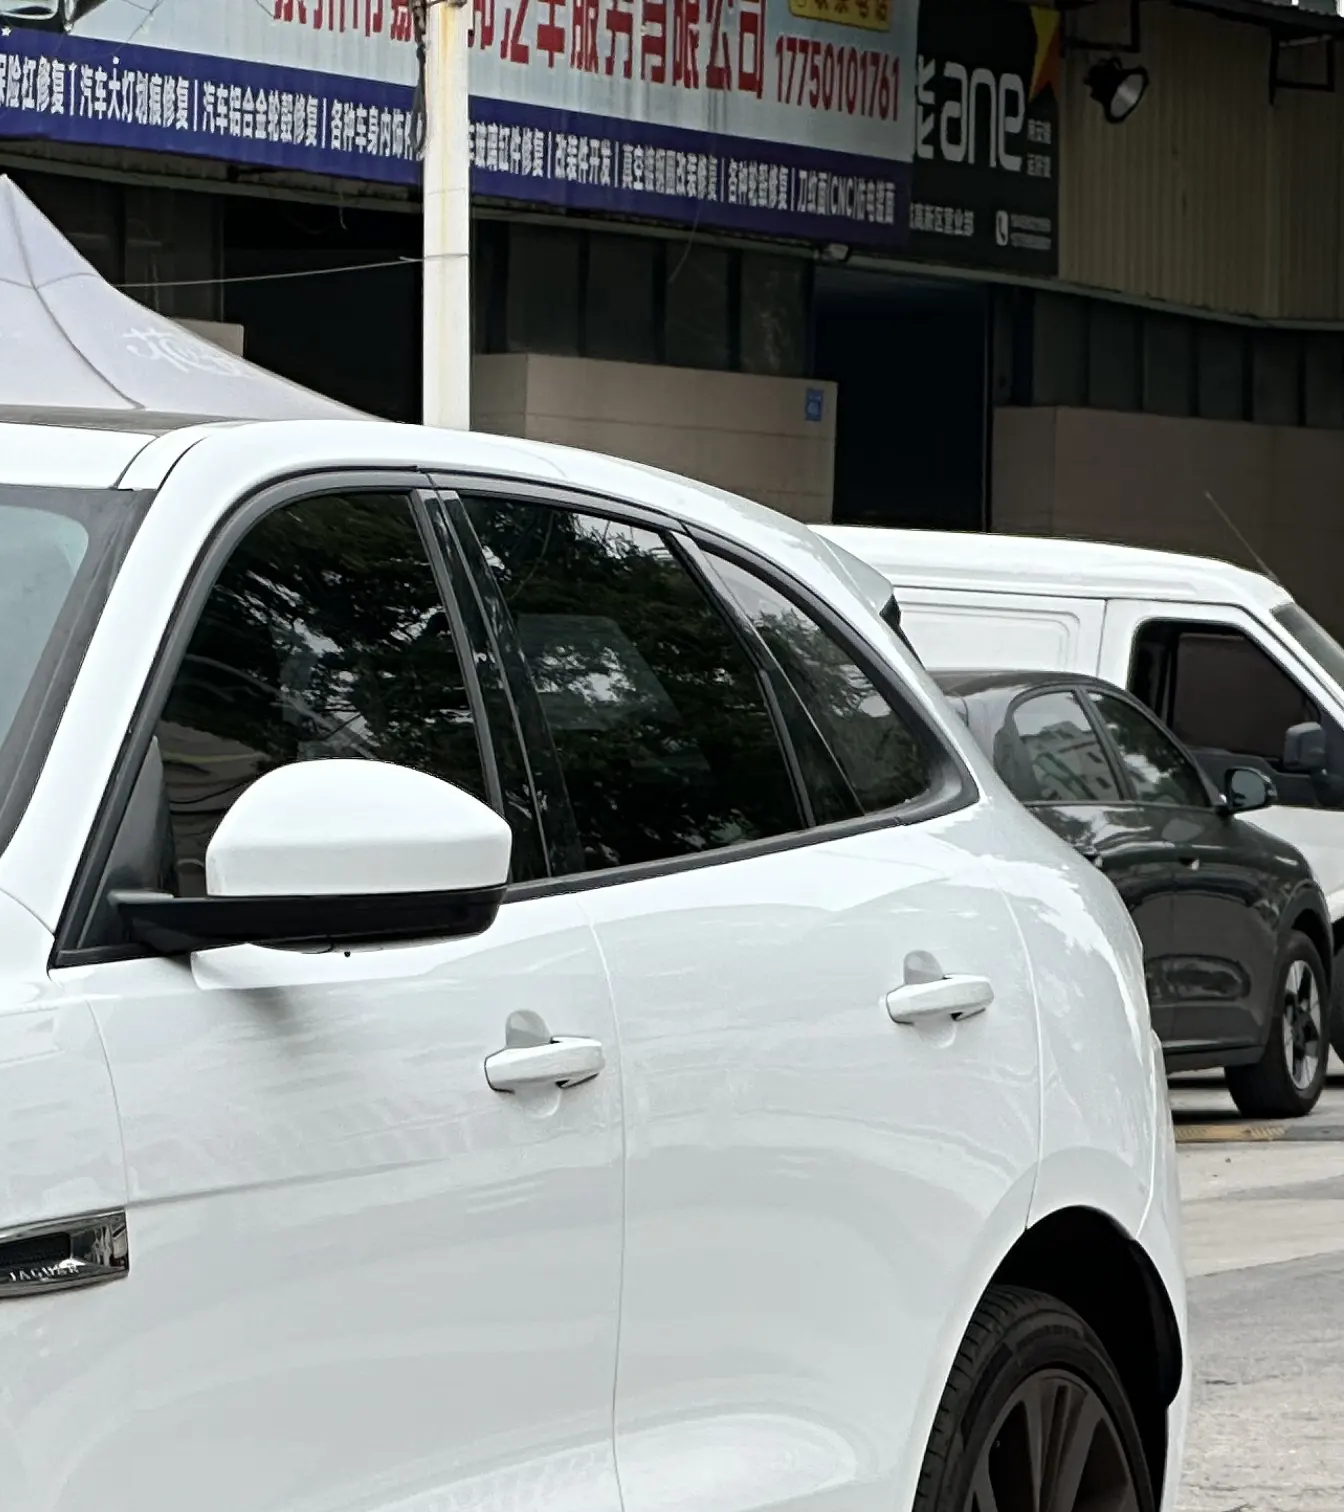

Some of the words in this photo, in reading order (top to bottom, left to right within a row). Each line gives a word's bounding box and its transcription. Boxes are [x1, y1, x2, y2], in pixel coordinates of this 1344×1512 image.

[80, 65, 189, 130] 汽车大灯划痕修复
[203, 81, 318, 146] 汽车铝合金轮毂修复
[775, 36, 900, 122] 17750101761
[940, 61, 1025, 172] ane
